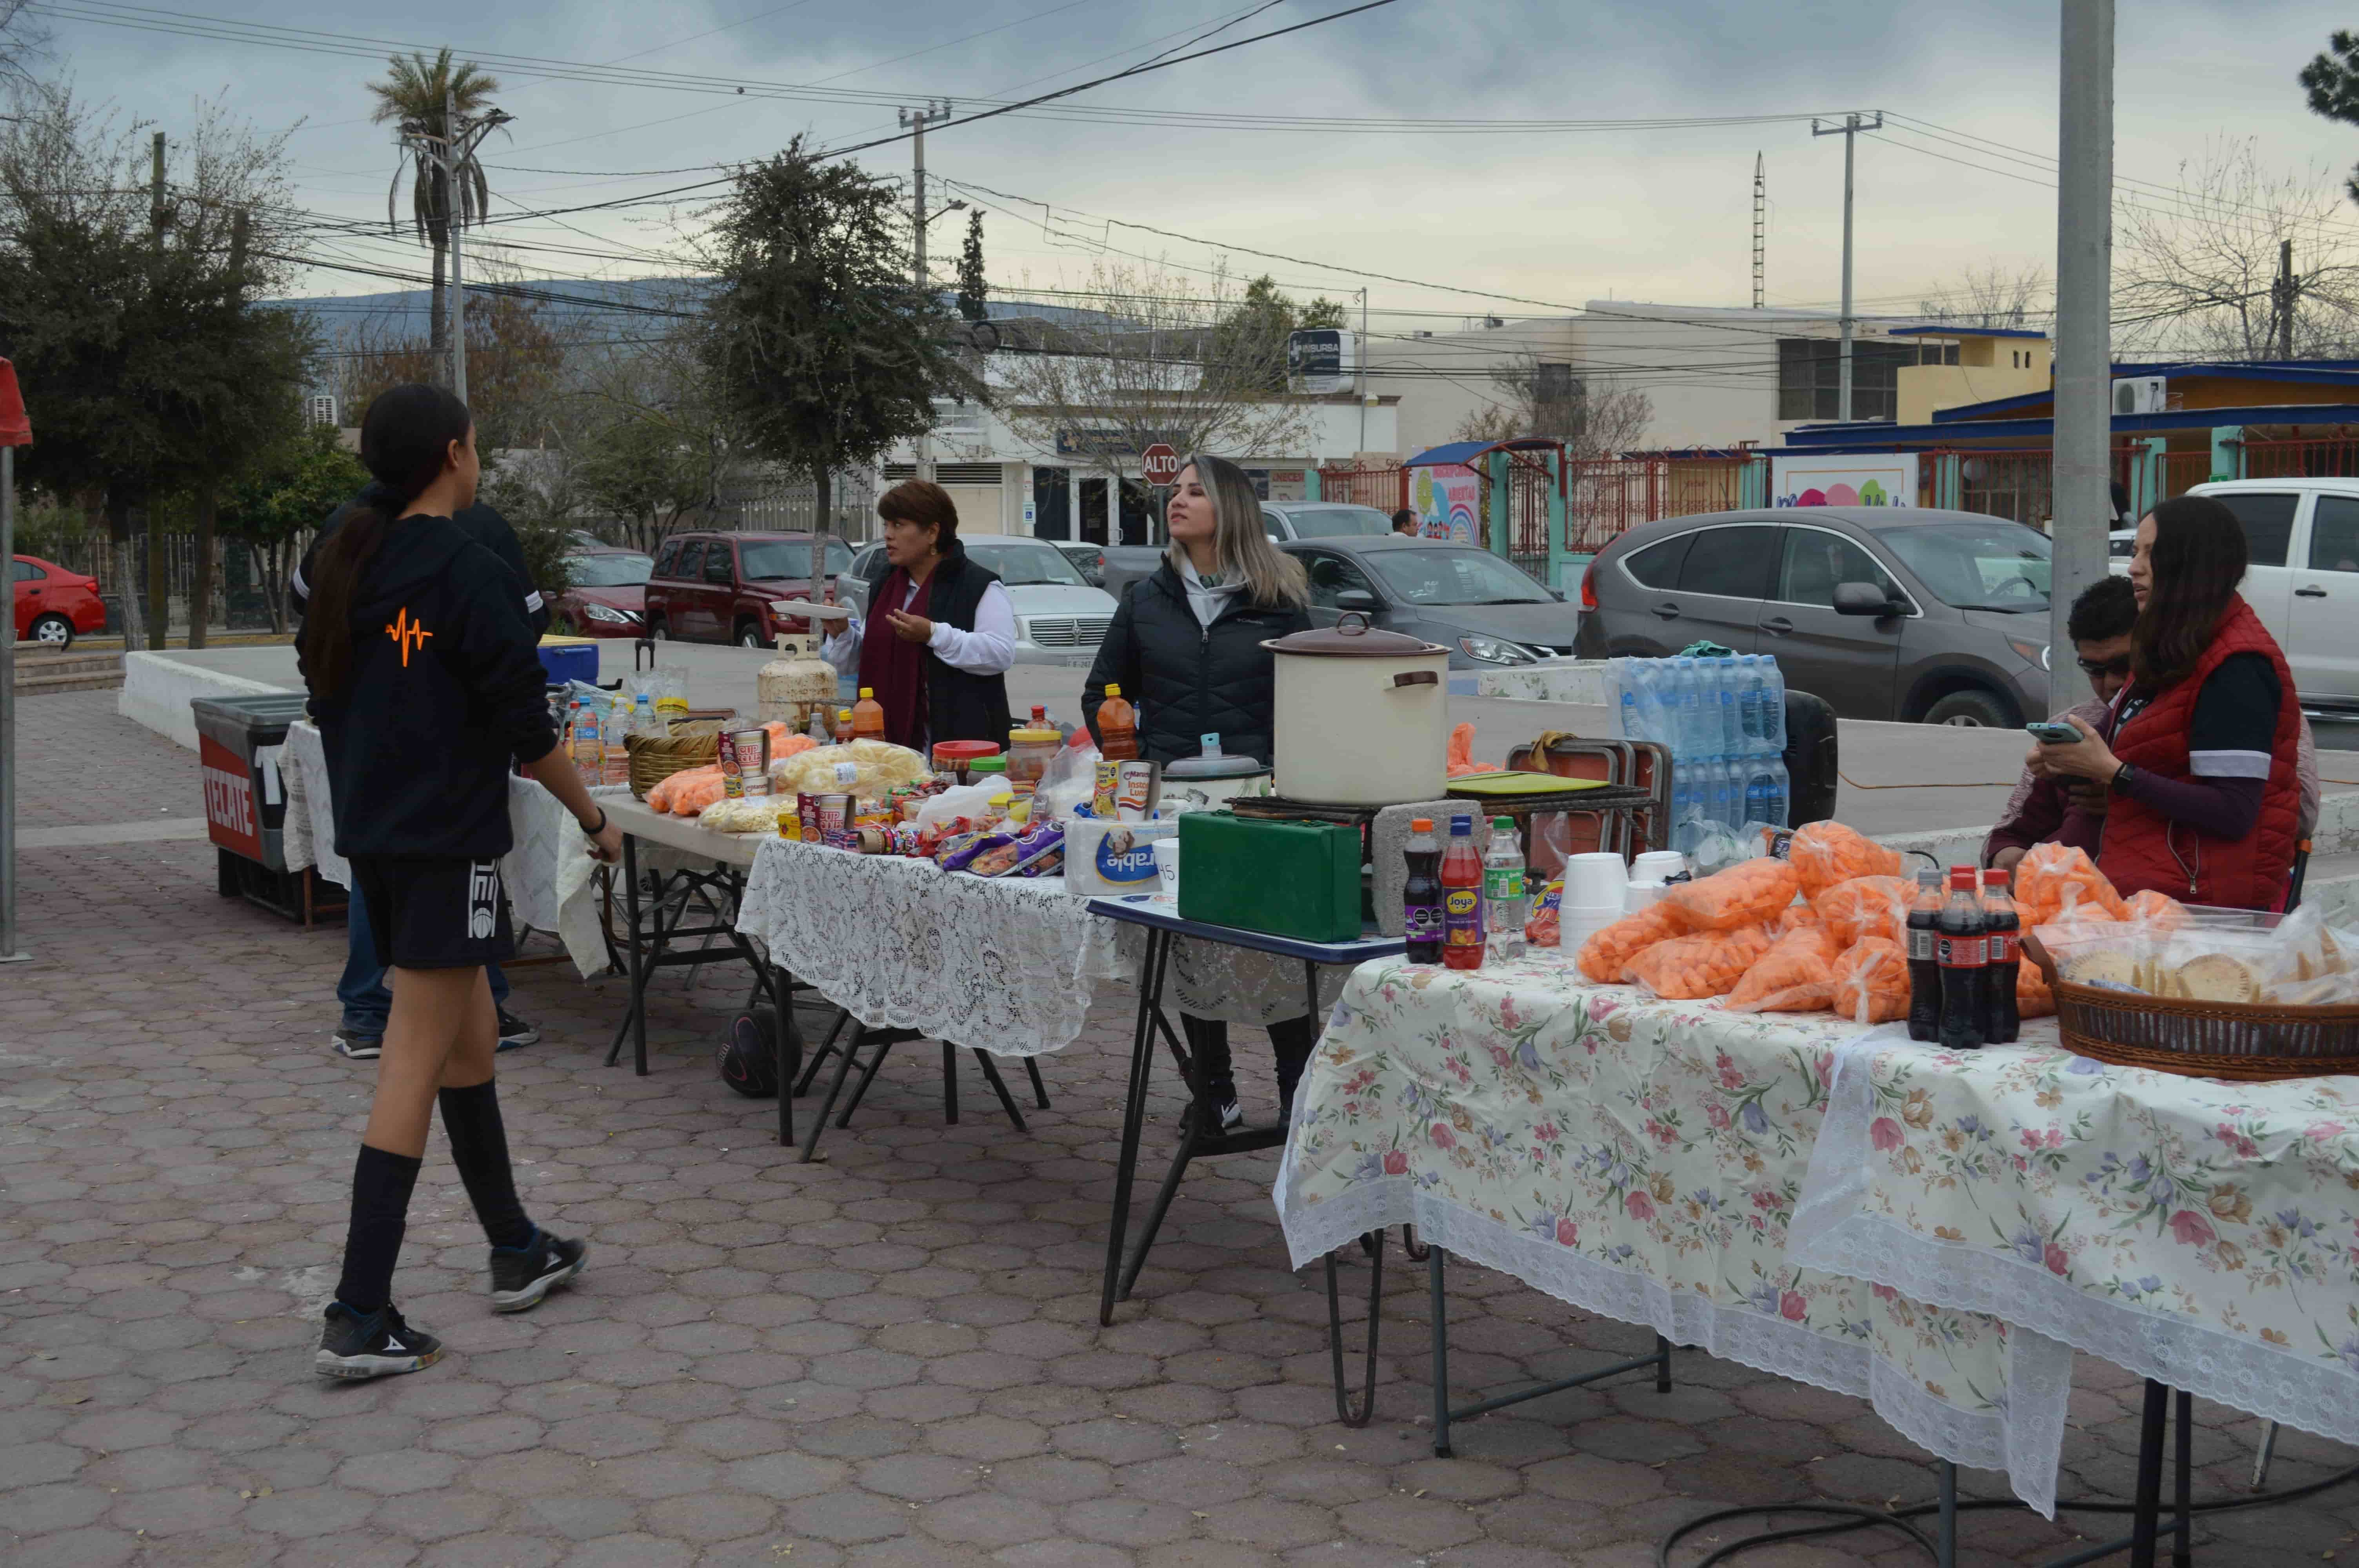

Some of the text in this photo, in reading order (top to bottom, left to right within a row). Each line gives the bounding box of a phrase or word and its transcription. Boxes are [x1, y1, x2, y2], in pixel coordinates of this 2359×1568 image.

[1302, 343, 1339, 353] INBURSA
[1144, 456, 1178, 472] ALTO
[202, 765, 253, 837] TECATE
[1160, 864, 1175, 880] 45
[1450, 897, 1472, 909] Joya
